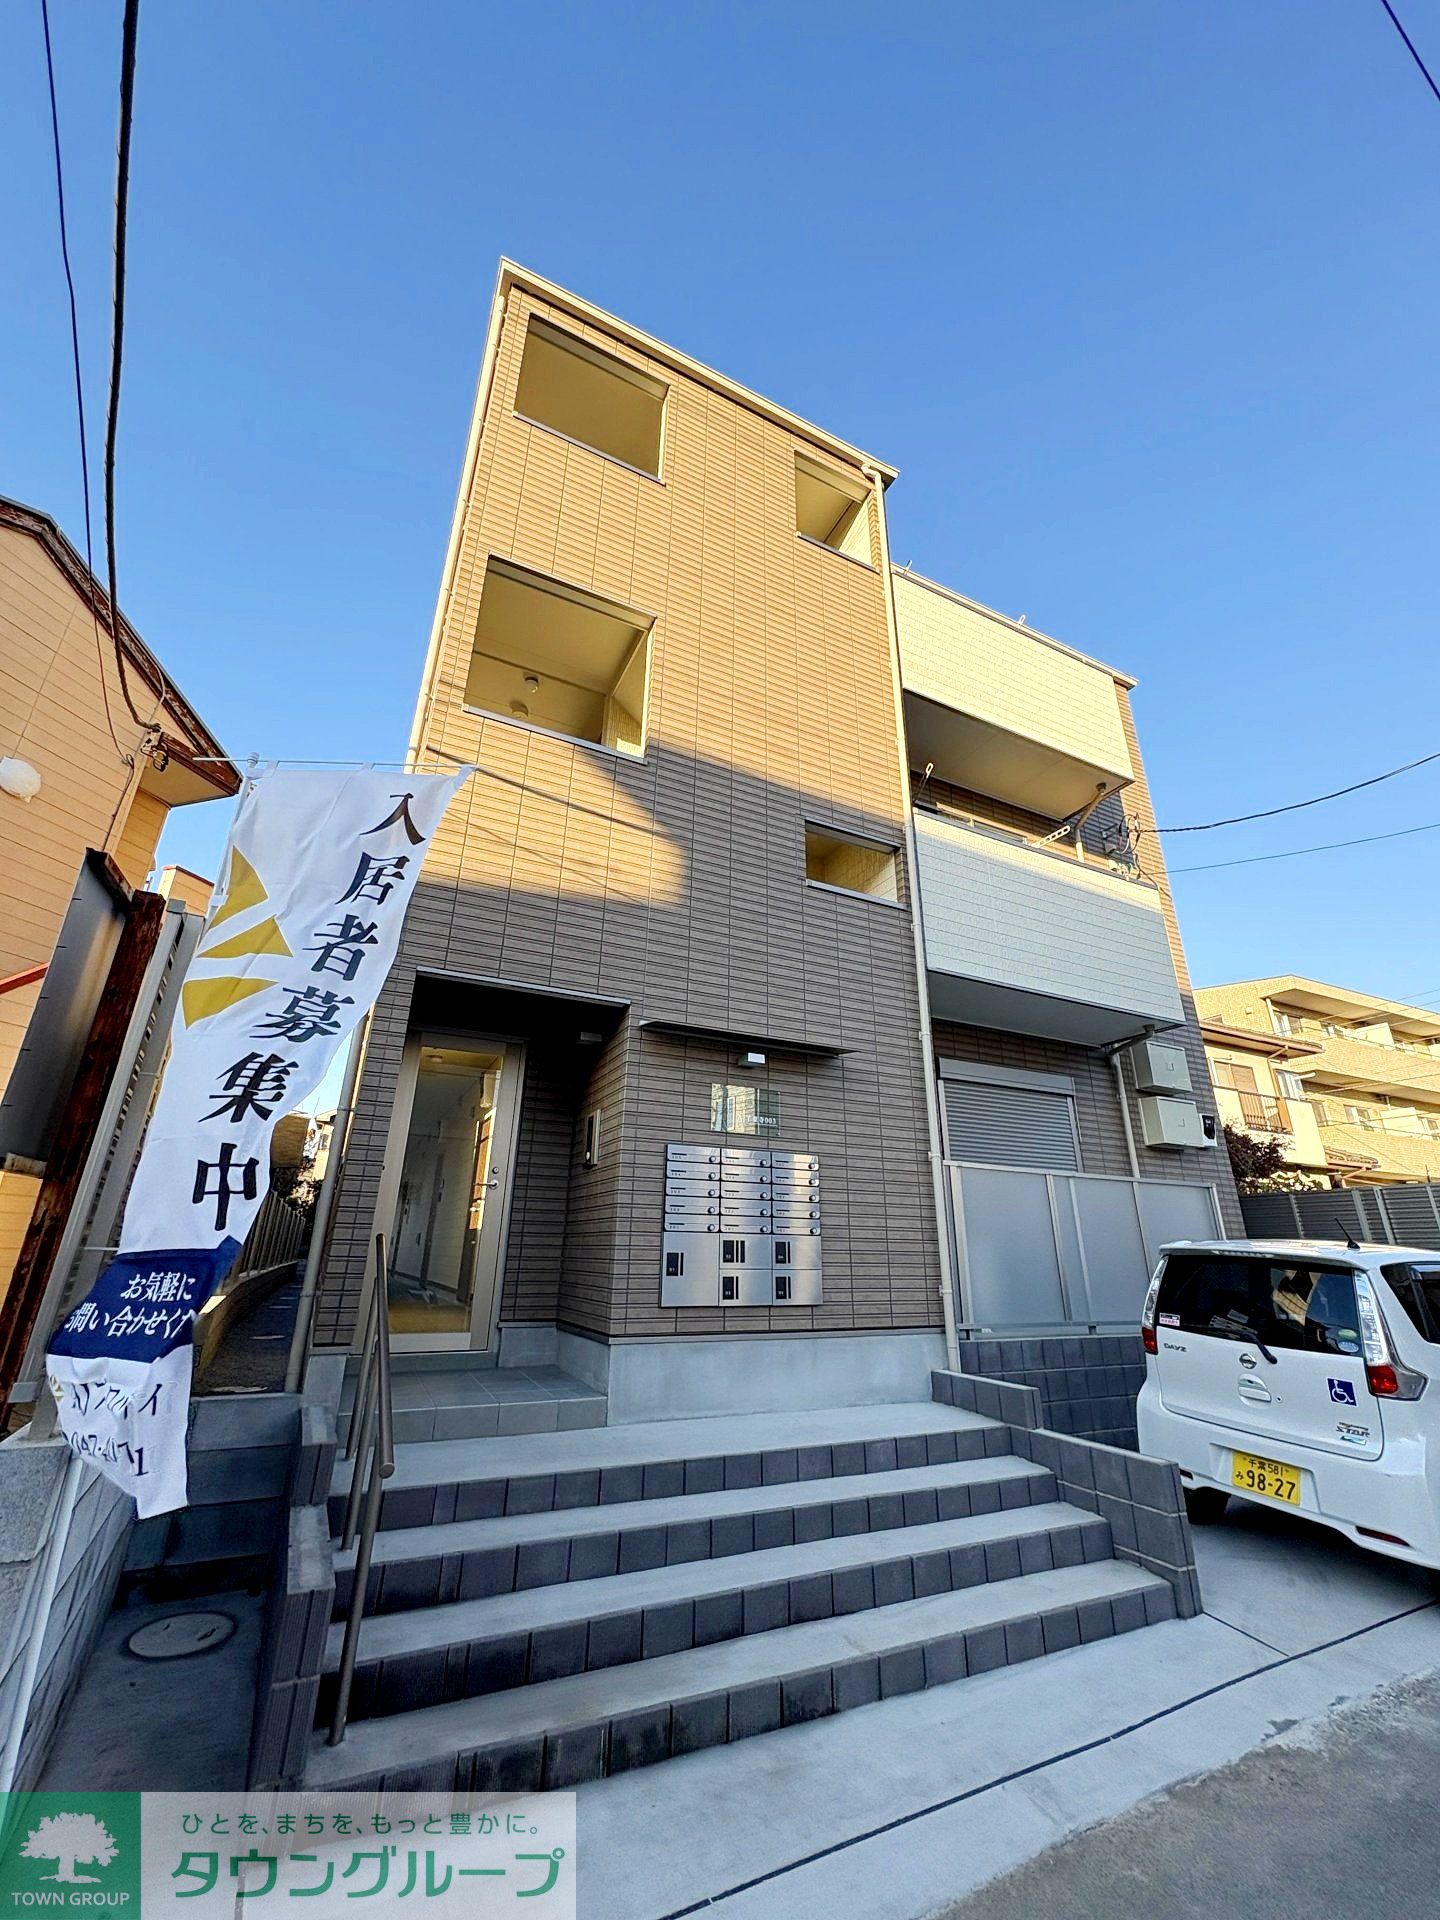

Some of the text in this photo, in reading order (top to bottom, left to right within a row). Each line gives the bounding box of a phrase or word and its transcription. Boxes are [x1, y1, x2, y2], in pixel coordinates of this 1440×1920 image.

[193, 792, 426, 1232] 入居者募集中
[120, 1271, 196, 1302] お気軽に
[1164, 1342, 1187, 1353] DAYZ
[1246, 1469, 1297, 1501] 98-27
